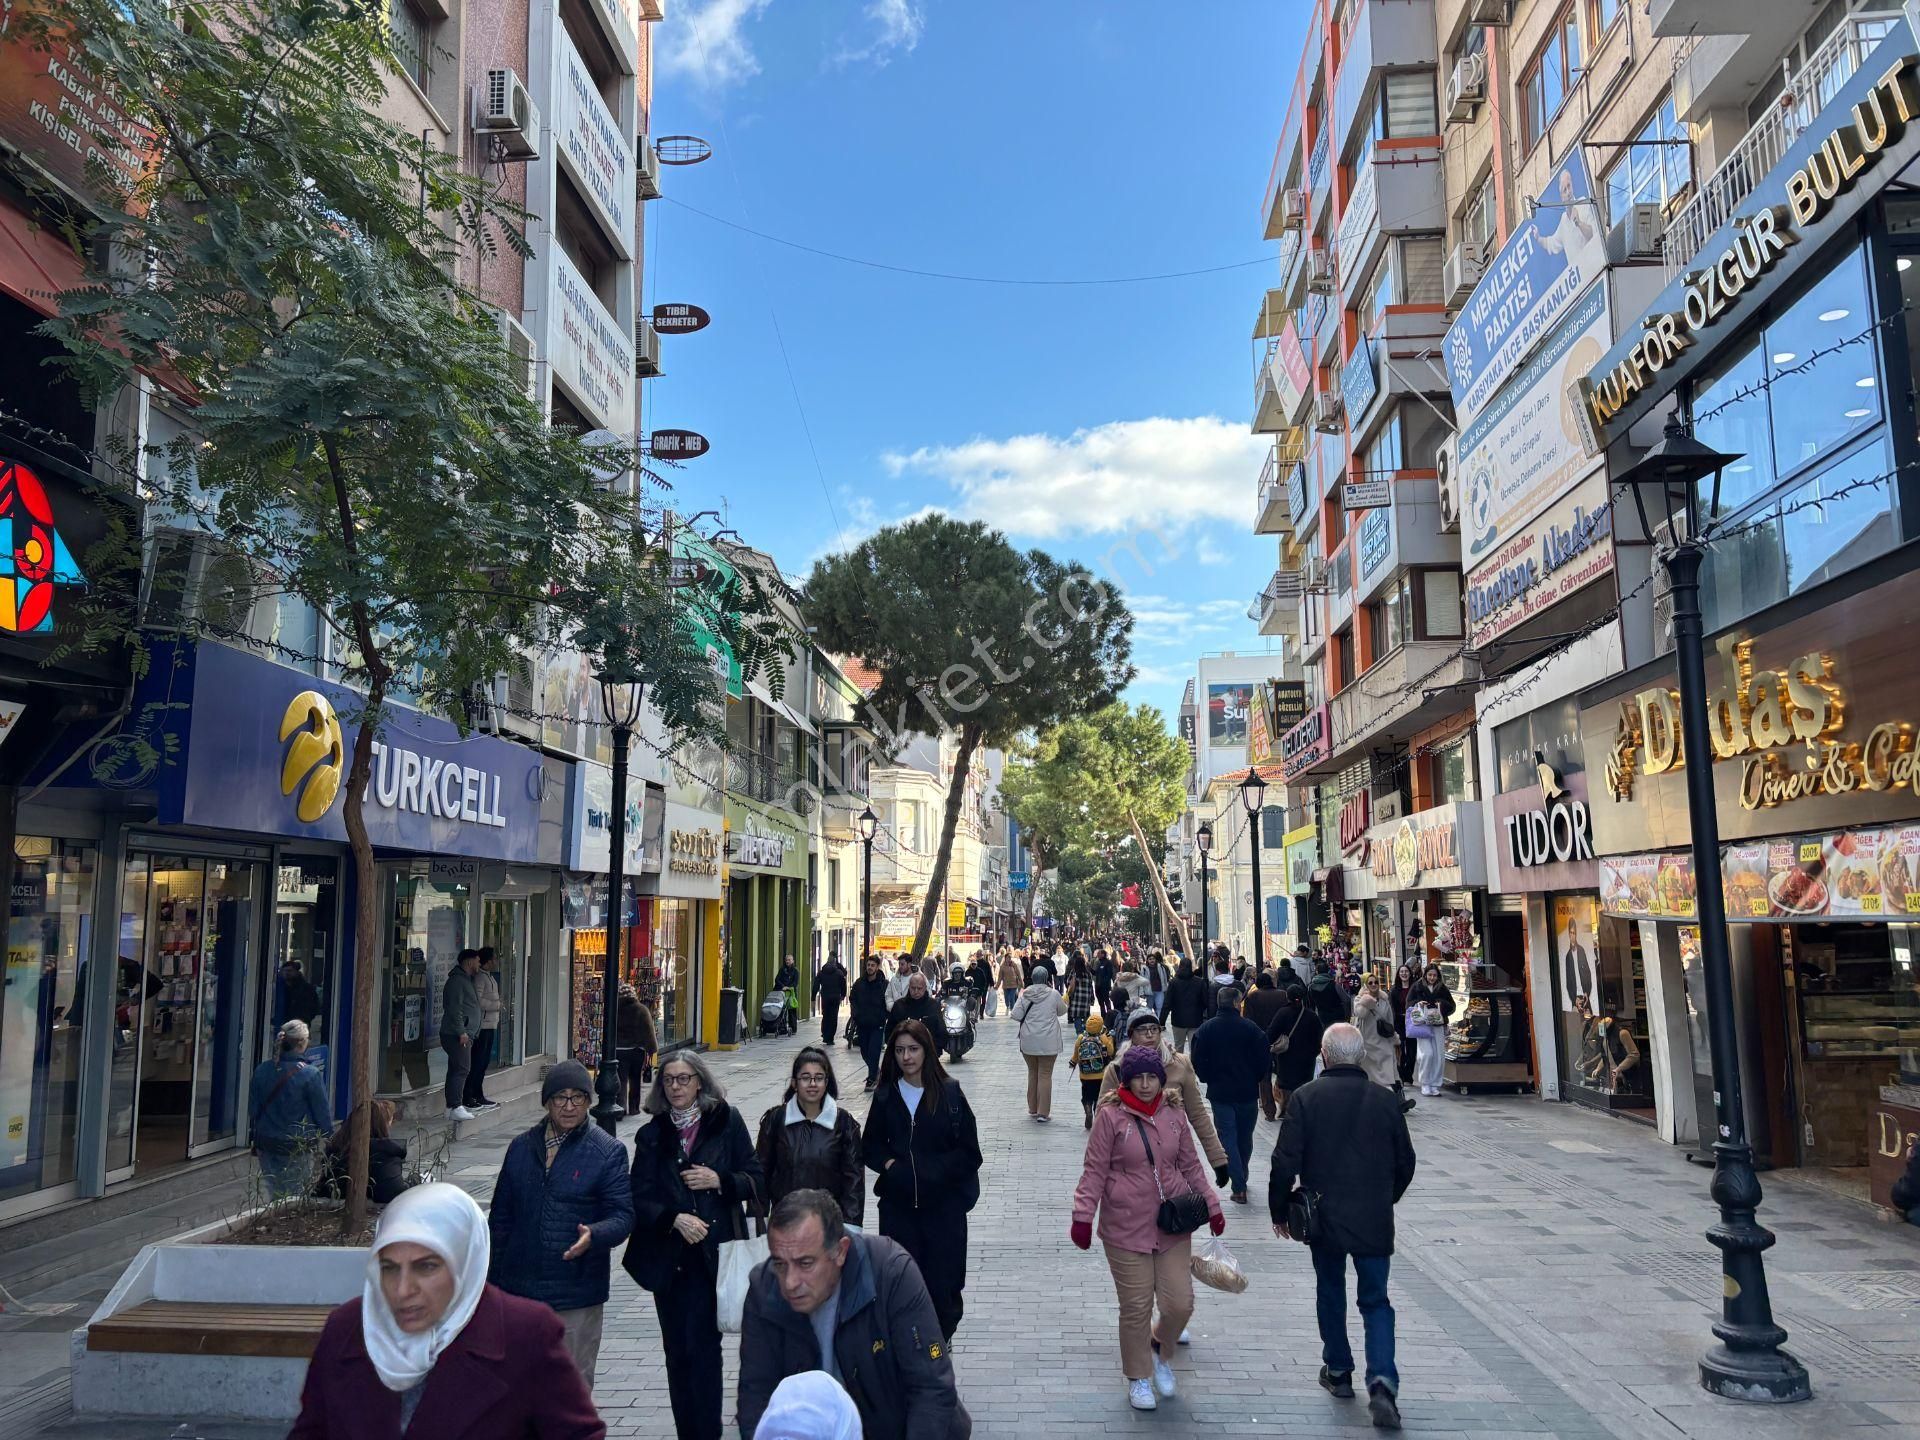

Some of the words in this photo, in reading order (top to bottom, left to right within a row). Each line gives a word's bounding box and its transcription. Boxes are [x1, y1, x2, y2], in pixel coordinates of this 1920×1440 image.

[48, 58, 97, 109] KABAK
[567, 51, 588, 109] İNSAN
[588, 97, 625, 175] KAYNAKLARI
[30, 100, 83, 154] KİŞİSEL
[590, 131, 616, 184] TİCARET
[568, 129, 588, 180] SATIŞ
[588, 169, 623, 232] PAZARLAMA
[1589, 313, 1683, 426] KUAFÖR
[1680, 207, 1785, 332] ÖZGÜR
[1784, 57, 1911, 229] BULUT
[557, 265, 600, 336] BİLGİSAYARLI
[665, 304, 690, 317] TIBBİ
[1470, 228, 1536, 333] MEMLEKET
[1484, 273, 1534, 353] PARTİSİ
[656, 317, 699, 328] SEKRETER
[1467, 359, 1505, 416] KARŞIYAKA
[1502, 336, 1523, 372] İLÇE
[1522, 264, 1583, 344] BAŞKANLIĞI
[653, 433, 680, 451] GRAFİK
[684, 435, 702, 450] WEB
[1509, 532, 1536, 561] Okulları
[1468, 556, 1540, 625] Hacettepe
[1475, 622, 1492, 646] 2005
[1523, 598, 1535, 617] Bu
[1535, 588, 1558, 611] Güne
[1635, 632, 1827, 775] Ddaş
[1739, 752, 1818, 811] Döner
[1822, 744, 1856, 796] &
[1503, 800, 1593, 868] TUDOR
